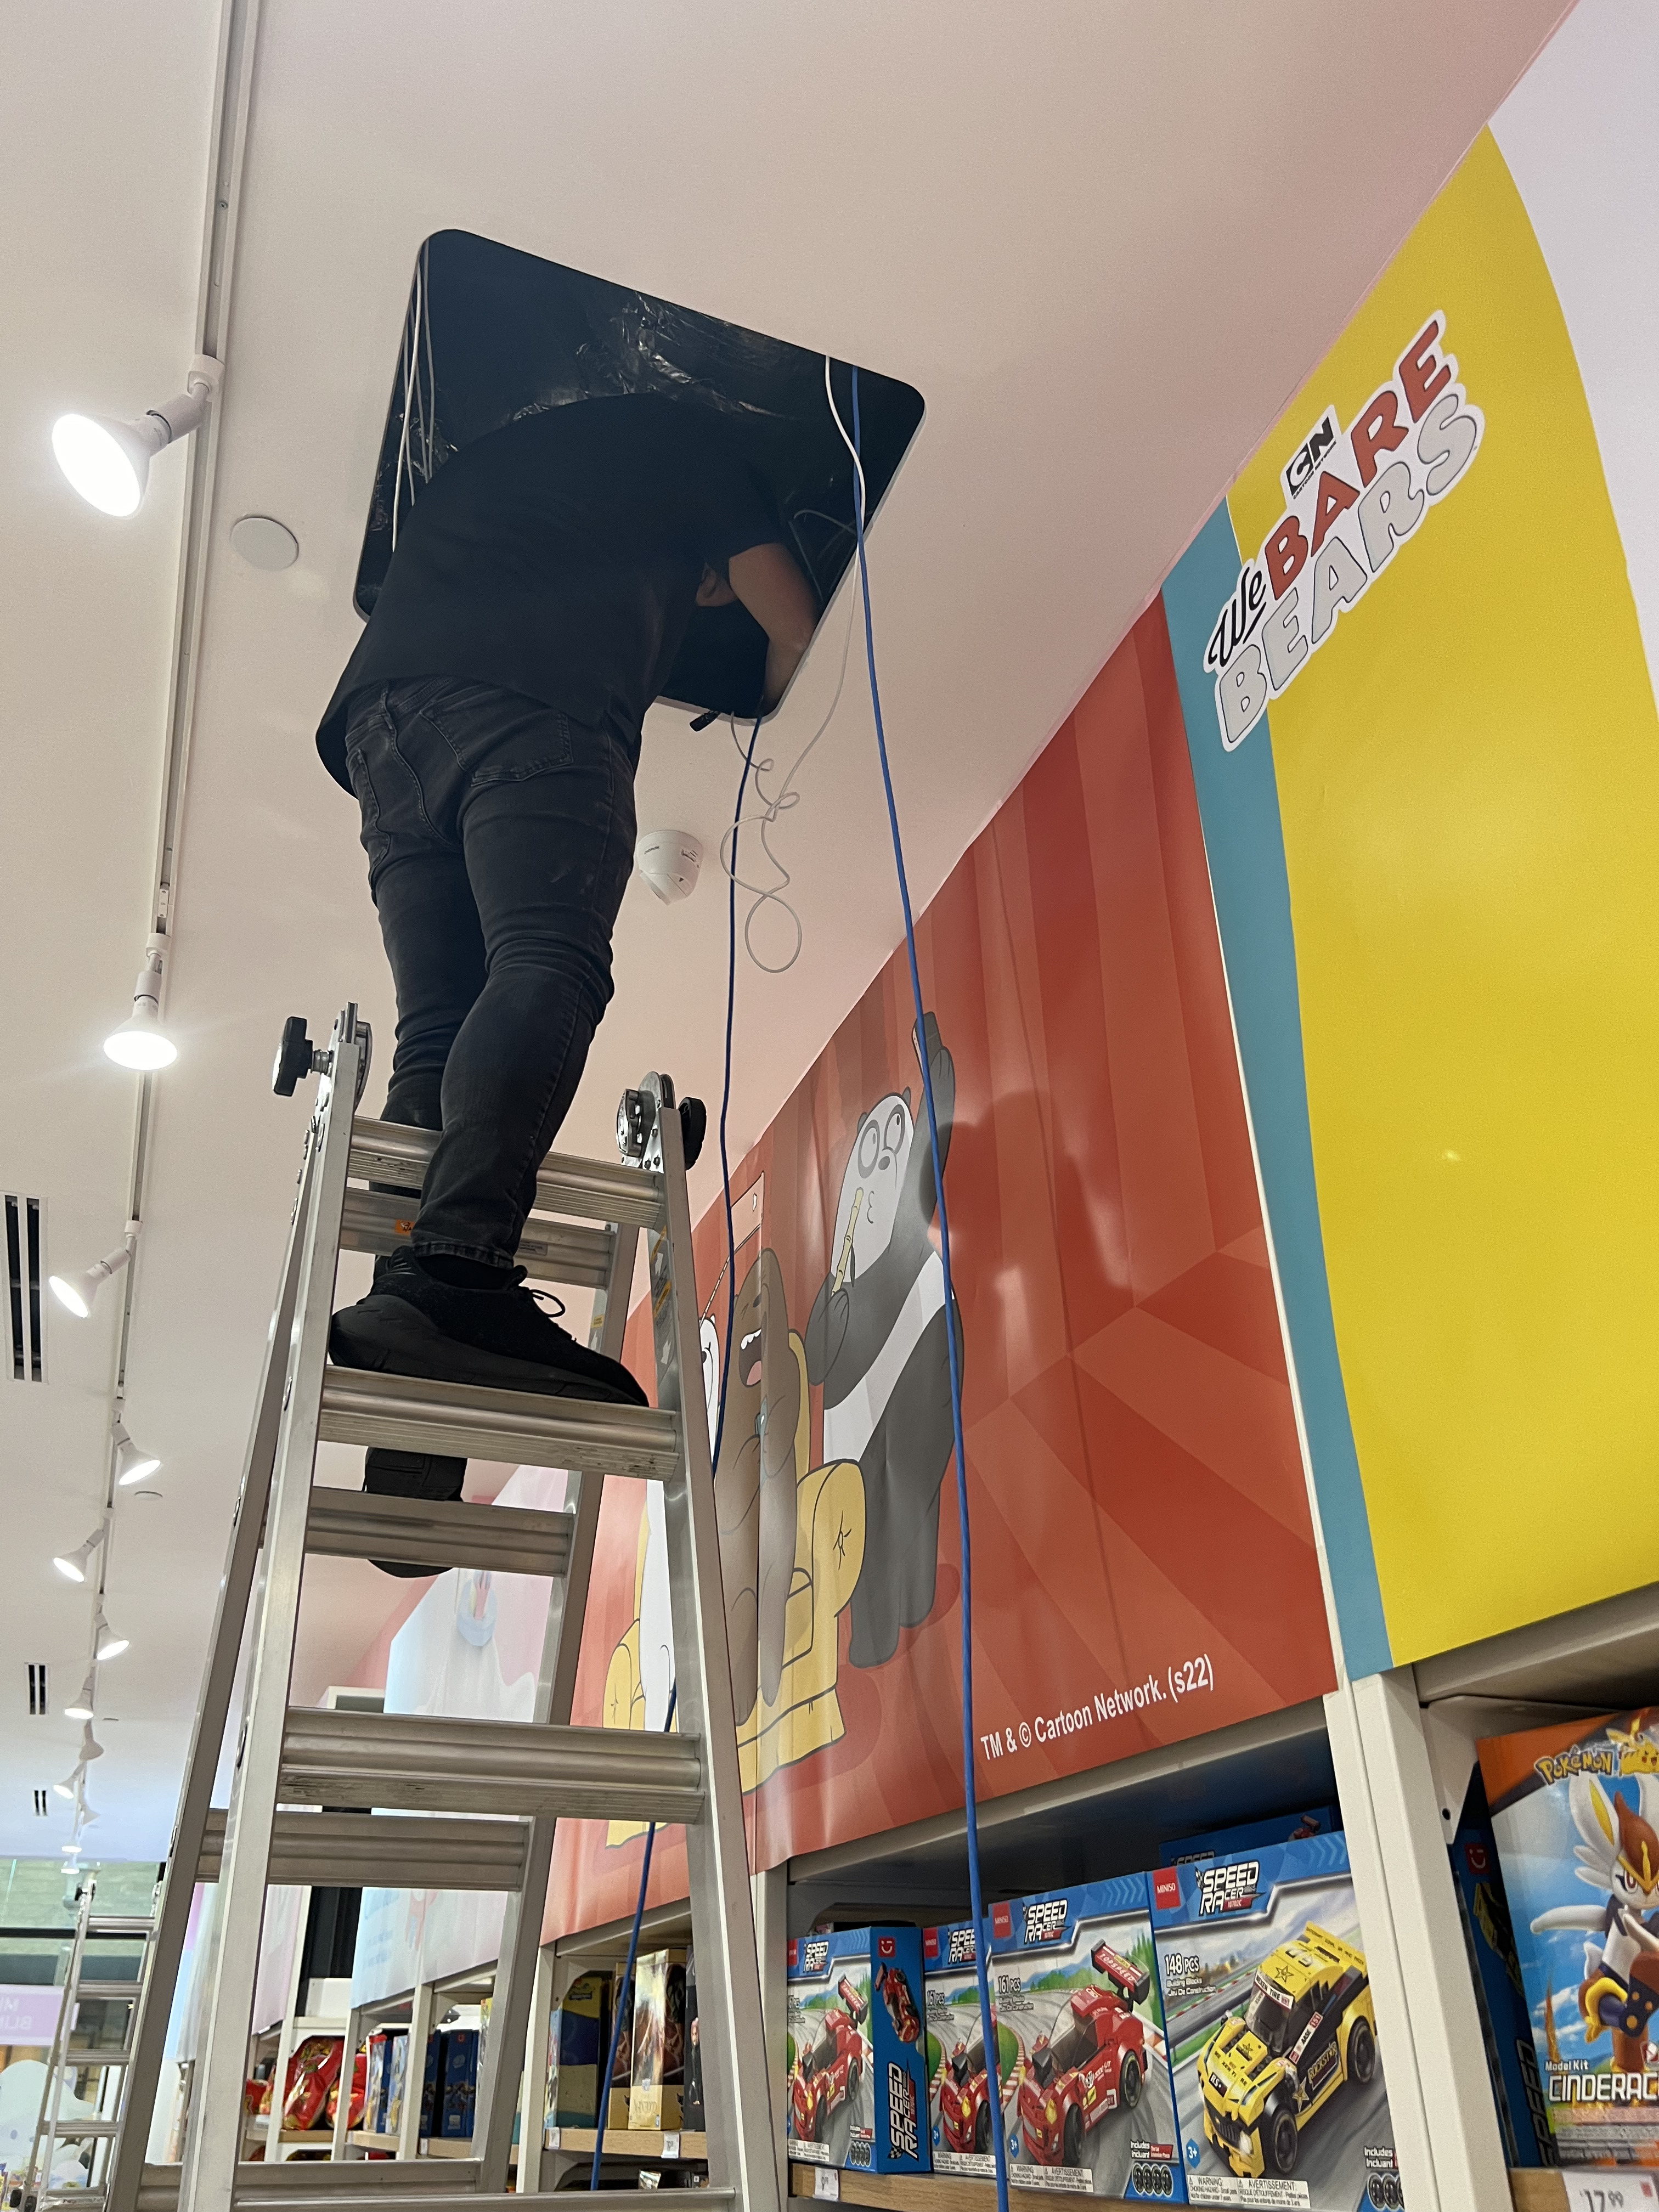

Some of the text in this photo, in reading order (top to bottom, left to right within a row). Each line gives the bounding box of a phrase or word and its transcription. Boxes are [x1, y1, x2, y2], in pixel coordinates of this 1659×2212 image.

[1285, 416, 1334, 496] CN
[1207, 320, 1452, 667] We BARE
[1218, 393, 1479, 743] BEARS
[980, 1732, 1003, 1760] TM
[1006, 1727, 1018, 1753] &
[1034, 1705, 1093, 1742] Cartoon
[1094, 1675, 1167, 1722] Network.
[1168, 1654, 1214, 1703] (s22)
[1156, 1882, 1176, 1894] MINISO
[1203, 1861, 1259, 1893] SPEED
[1200, 1887, 1244, 1914] RACER
[1028, 1899, 1067, 1925] SPEED
[951, 1928, 975, 1948] SPEE
[1024, 1921, 1056, 1943] RACER
[806, 1942, 828, 1957] SPEED
[1165, 1953, 1200, 1975] 148 PCS
[998, 1975, 1021, 1994] 161 PCS
[1545, 2059, 1589, 2071] Model Kit
[1549, 2072, 1659, 2101] CINDERAC
[889, 2062, 905, 2151] SPEED
[903, 2087, 918, 2159] RACER
[1010, 2139, 1018, 2149] 3+
[1187, 2146, 1198, 2159] 3+
[1364, 2146, 1393, 2157] Includes
[1366, 2158, 1393, 2168] Incluant
